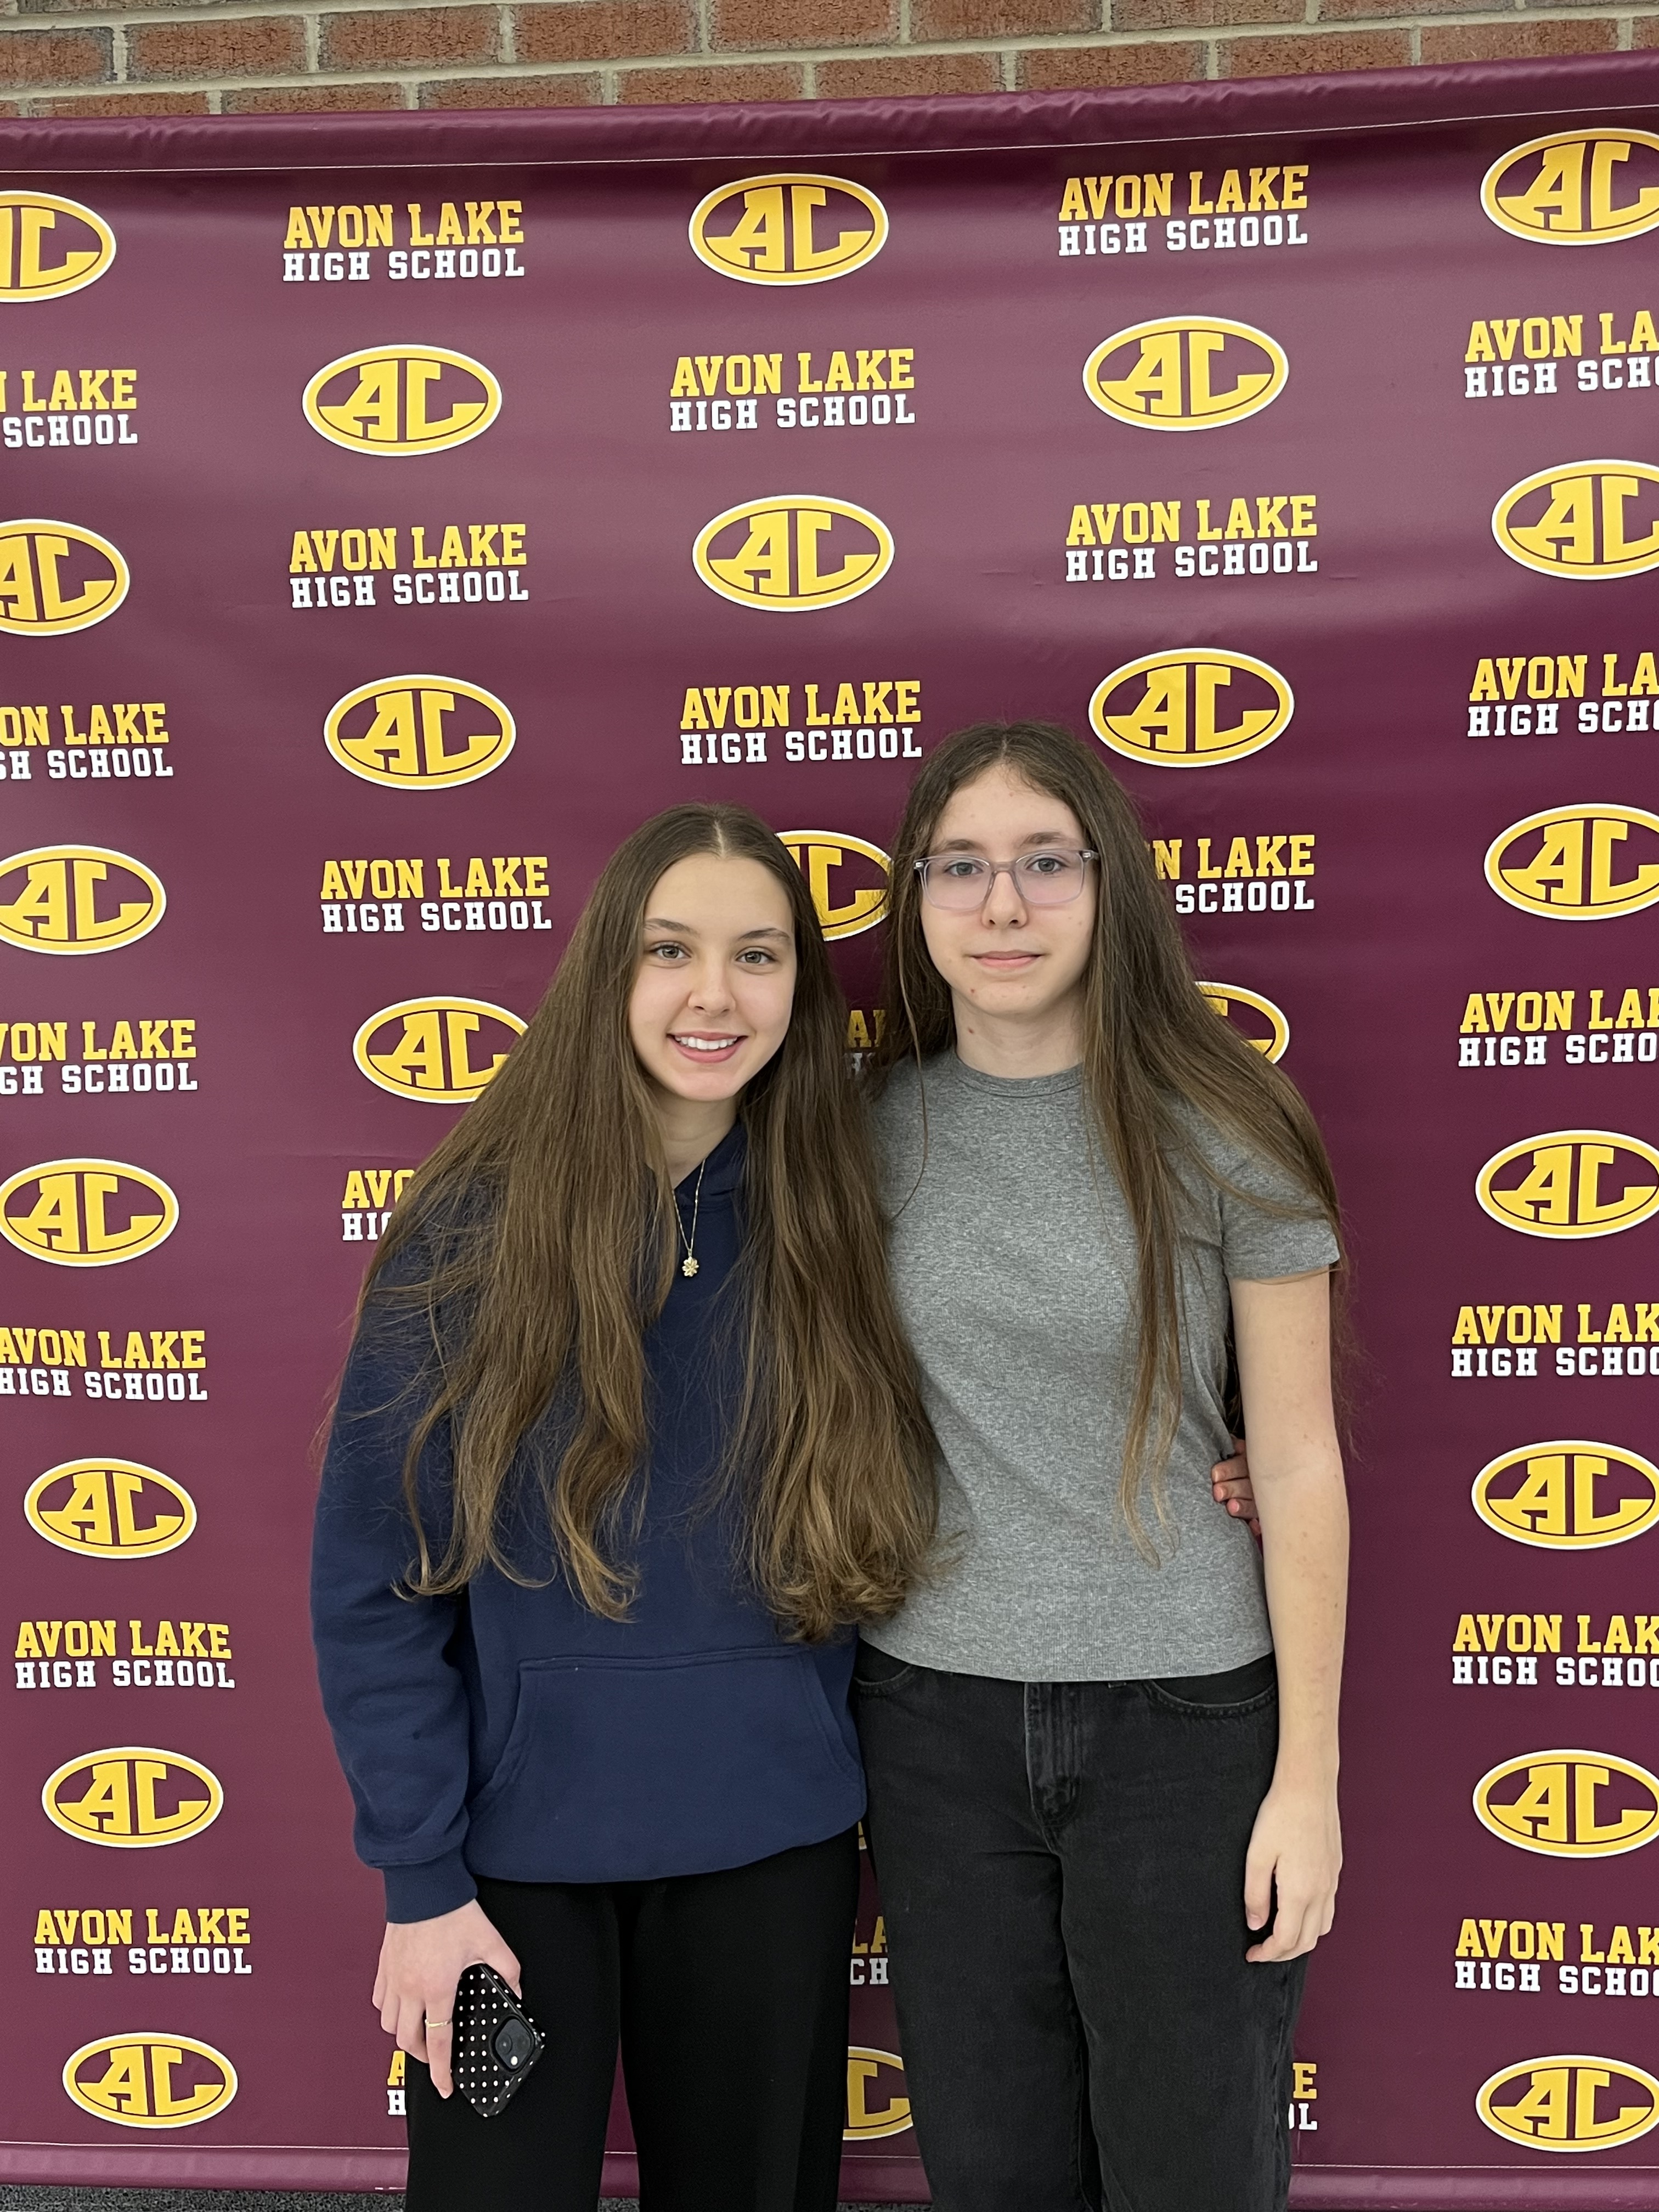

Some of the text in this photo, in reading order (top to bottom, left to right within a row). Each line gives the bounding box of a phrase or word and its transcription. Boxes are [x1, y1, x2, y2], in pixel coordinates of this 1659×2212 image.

[1059, 164, 1309, 221] AVON LAKE
[1499, 140, 1659, 233] AL
[285, 200, 524, 249] AVON LAKE
[707, 185, 871, 273] AL
[1058, 213, 1308, 256] HIGH SCHOOL
[0, 207, 99, 289] L
[283, 248, 524, 281] HIGH SCHOOL
[1466, 312, 1659, 362] AVON LA
[22, 370, 138, 411] LAKE
[672, 349, 913, 397] AVON LAKE
[1102, 332, 1270, 417] AL
[1464, 356, 1659, 398] HIGH SCH
[320, 360, 484, 443] AL
[670, 393, 915, 432] HIGH SCHOOL
[2, 414, 138, 448] SCHOOL
[1067, 496, 1317, 545] AVON LAKE
[1511, 477, 1659, 565] AL
[290, 524, 527, 573] AVON LAKE
[710, 511, 876, 597] AL
[1065, 540, 1318, 582] HIGH SCHOOL
[290, 569, 529, 608] HIGH SCHOOL
[1470, 653, 1659, 701] AVON LA
[0, 703, 171, 746] ON LAKE
[680, 681, 921, 730] AVON LAKE
[1107, 664, 1276, 753] AL
[1468, 699, 1659, 737] HIGH SCH
[342, 690, 499, 775] AL
[680, 727, 922, 764] HIGH SCHOOL
[47, 748, 173, 778] SCHOOL
[320, 857, 551, 900] AVON LAKE
[1198, 835, 1314, 879] LAKE
[1502, 820, 1659, 906] AL
[0, 861, 151, 941] AL
[785, 844, 888, 927] L
[1176, 880, 1314, 913] SCHOOL
[320, 901, 552, 933] HIGH SCHOOL
[1460, 989, 1659, 1033] AVON LA
[0, 1020, 197, 1062] ON LAKE
[369, 1012, 509, 1090] AL
[1458, 1032, 1657, 1067] HIGH SCHO
[0, 1062, 198, 1094] GH SCHOOL
[1493, 1145, 1655, 1225] AL
[7, 1173, 162, 1254] AL
[341, 1212, 392, 1241] HI
[1452, 1304, 1659, 1346] AVON LAK
[99, 1331, 207, 1369] LAKE
[1451, 1347, 1537, 1377] HIGH
[0, 1367, 208, 1401] HIGH SCHOOL
[40, 1472, 183, 1547] AL
[1488, 1454, 1652, 1536] AL
[15, 1621, 233, 1660] AVON LAKE
[1453, 1615, 1659, 1655] AVON LAK
[15, 1660, 235, 1689] HIGH SCHOOL
[1452, 1656, 1538, 1685] HIGH
[59, 1760, 208, 1836] AL
[1489, 1763, 1654, 1844] AL
[35, 1909, 251, 1945] AVON LAKE
[1456, 1919, 1659, 1965] AVON LAK
[34, 1948, 252, 1975] HIGH SCHOOL
[1455, 1961, 1659, 1996] HIGH SCHO
[80, 2045, 223, 2117] AL
[848, 2059, 911, 2128] L
[1492, 2068, 1650, 2140] AL
